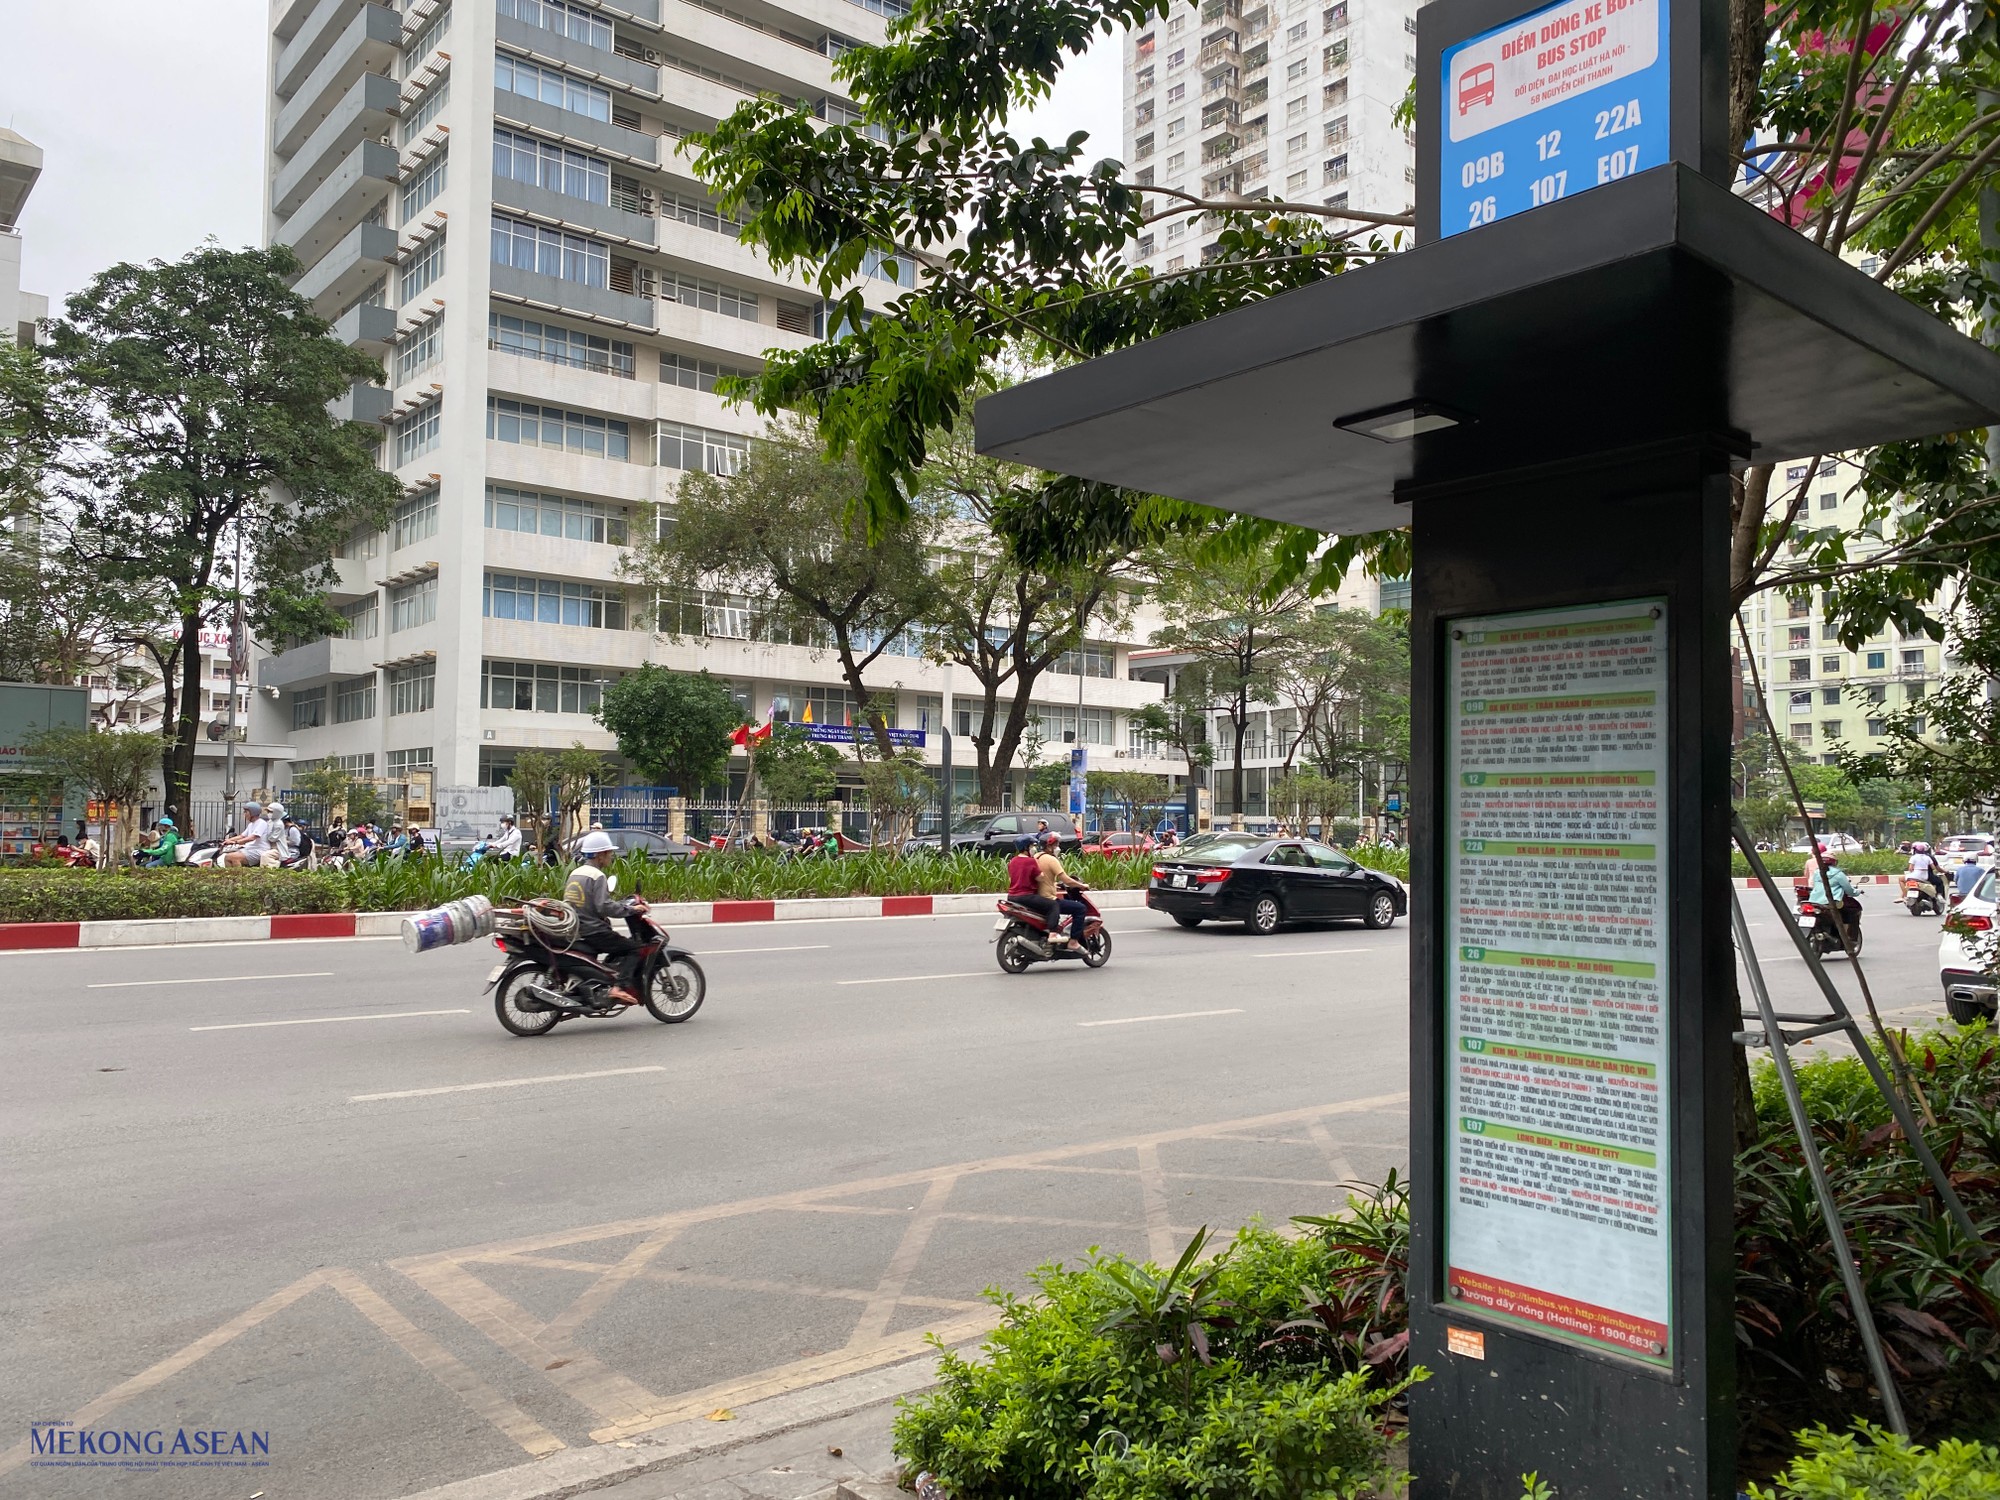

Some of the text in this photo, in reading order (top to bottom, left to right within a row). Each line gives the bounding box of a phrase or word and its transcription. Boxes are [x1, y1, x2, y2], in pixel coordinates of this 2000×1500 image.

[1501, 30, 1536, 60] ĐIỂM
[1541, 12, 1580, 44] DỪNG
[1584, 3, 1602, 25] XE
[1537, 26, 1607, 70] BUS STOP
[1528, 77, 1545, 92] DIỆN
[1562, 64, 1578, 79] HỌC
[1579, 55, 1597, 72] LUẬT
[1600, 50, 1611, 63] HÀ
[1612, 44, 1625, 58] NỘI
[1541, 81, 1571, 101] NGUYỄN
[1572, 76, 1586, 89] CHÍ
[1587, 65, 1613, 82] THANH
[1461, 98, 1642, 189] 09B 12 22A
[1468, 144, 1639, 229] 26 107 E07
[1466, 701, 1483, 711] 09B
[486, 730, 493, 739] A
[1469, 774, 1478, 783] 12
[1466, 840, 1483, 850] 22A
[1468, 948, 1479, 959] 26
[1467, 1038, 1481, 1050] 107
[1467, 1119, 1482, 1132] E07
[1575, 1144, 1600, 1155] SMART
[1602, 1149, 1619, 1159] CITY
[1458, 1275, 1496, 1293] Website:
[1575, 1307, 1657, 1337] http://timbuyt.vn
[1496, 1298, 1515, 1311] dây
[1517, 1303, 1544, 1320] nóng
[1546, 1311, 1597, 1334] (Hotline):
